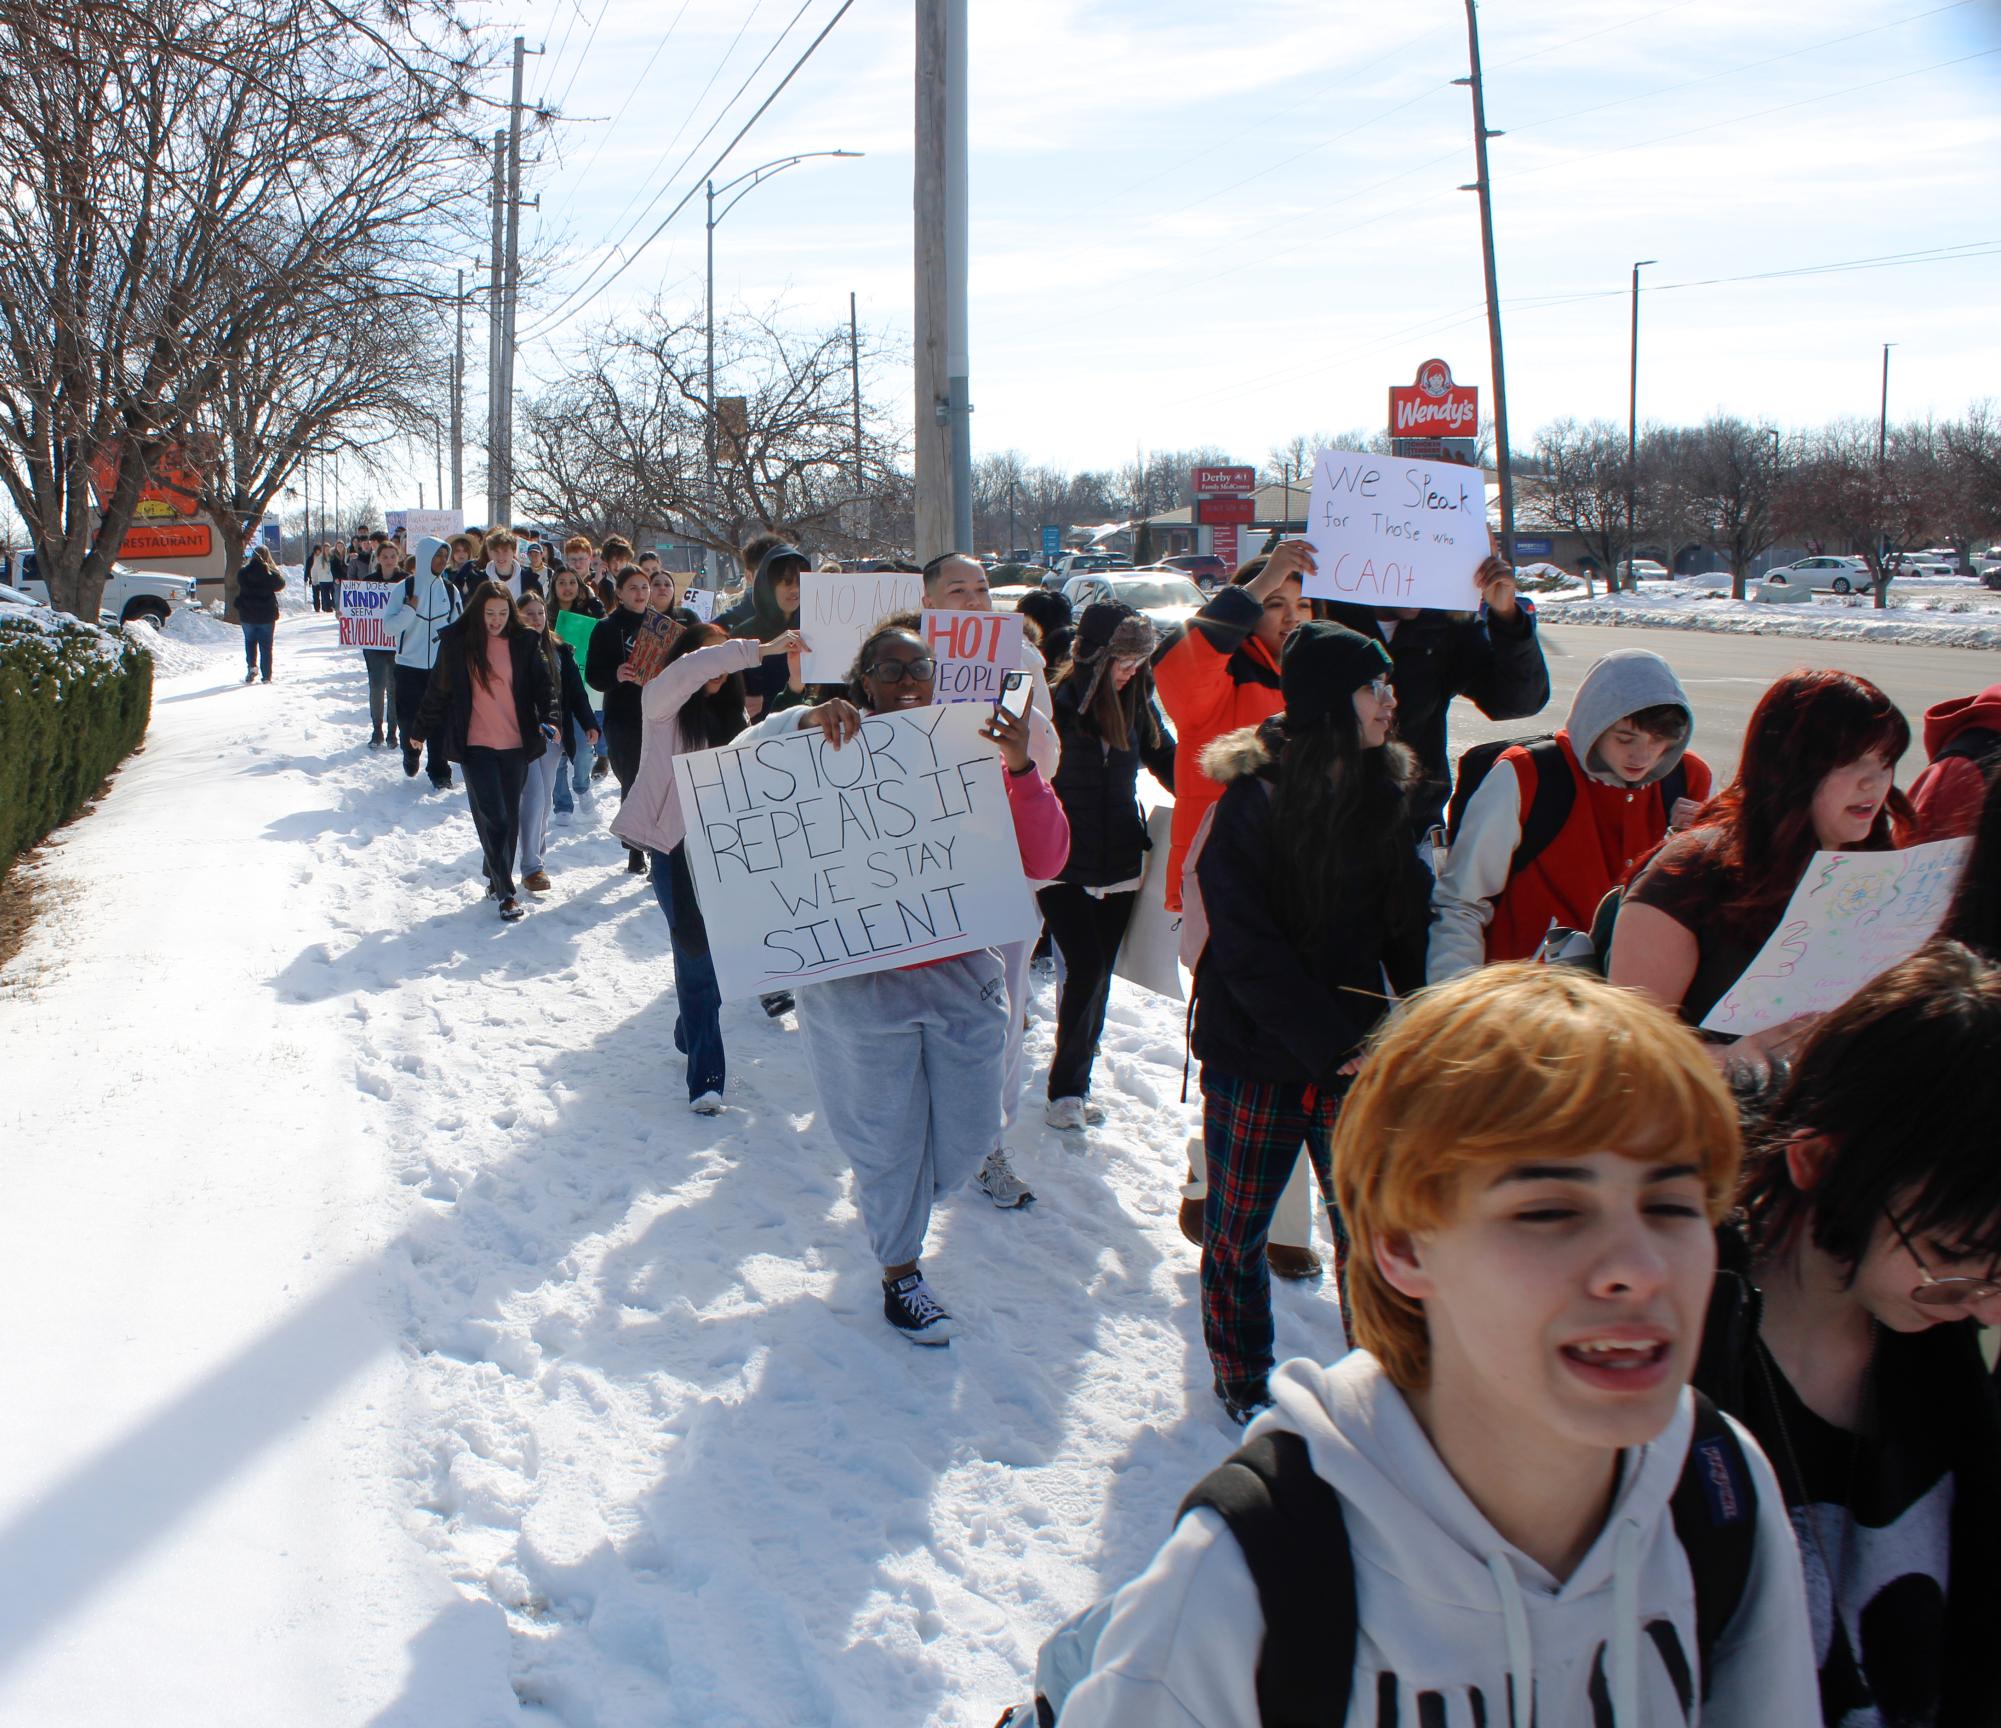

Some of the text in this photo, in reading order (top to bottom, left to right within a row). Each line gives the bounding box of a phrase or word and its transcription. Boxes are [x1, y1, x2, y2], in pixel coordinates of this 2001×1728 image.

[1397, 393, 1474, 429] Wendy's
[1202, 472, 1232, 485] Derby
[1325, 462, 1381, 497] We
[1322, 501, 1350, 528] for
[124, 535, 205, 549] RESTAURANT
[343, 582, 389, 591] WHY DOES
[815, 583, 856, 625] NO
[350, 608, 373, 617] SEEM
[927, 615, 1011, 663] HOT
[686, 706, 946, 836] HISTORY
[707, 756, 995, 883] REPEATS IF
[770, 835, 956, 917] WE STAY
[763, 882, 967, 974] SILENT
